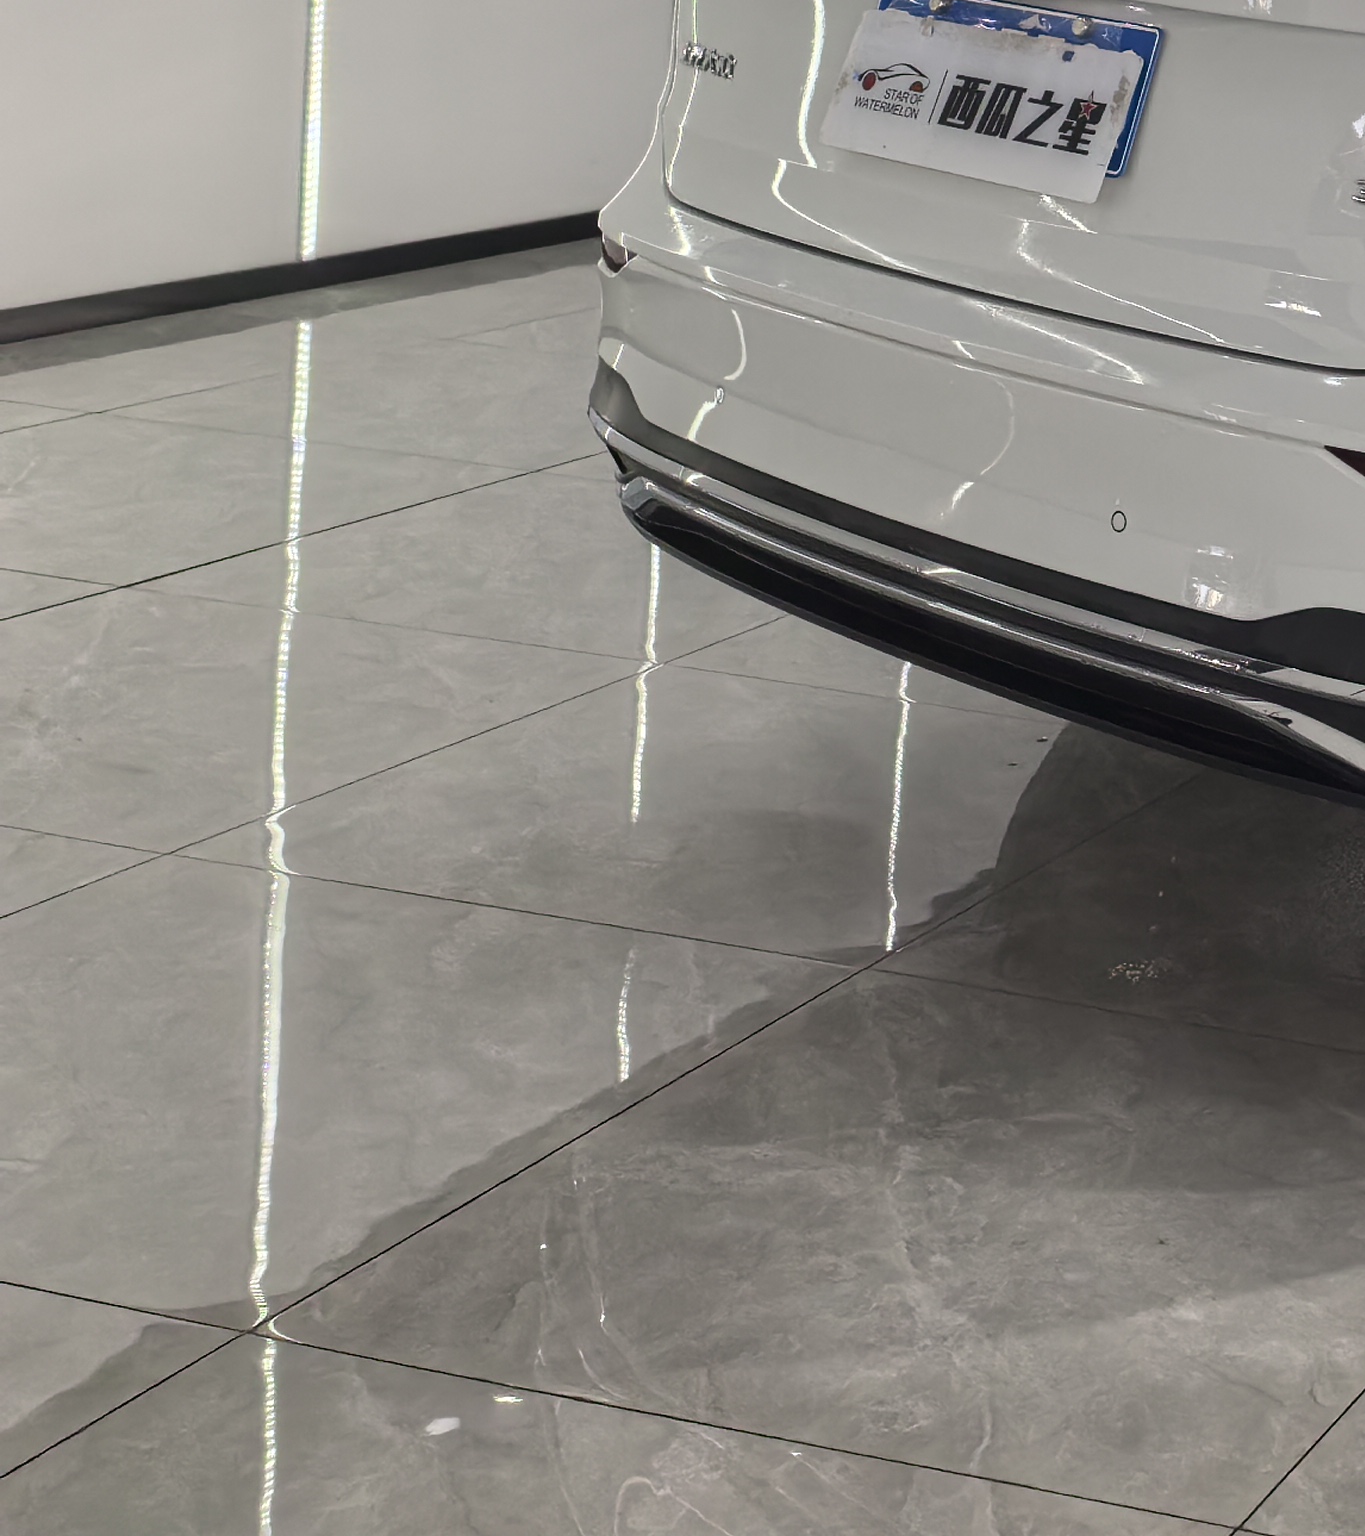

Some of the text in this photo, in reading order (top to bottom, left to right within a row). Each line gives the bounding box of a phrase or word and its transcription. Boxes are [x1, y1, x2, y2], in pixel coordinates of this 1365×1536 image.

[854, 95, 920, 120] WATERMELON
[883, 88, 925, 106] STAR OF
[936, 74, 1108, 156] 西瓜之星
